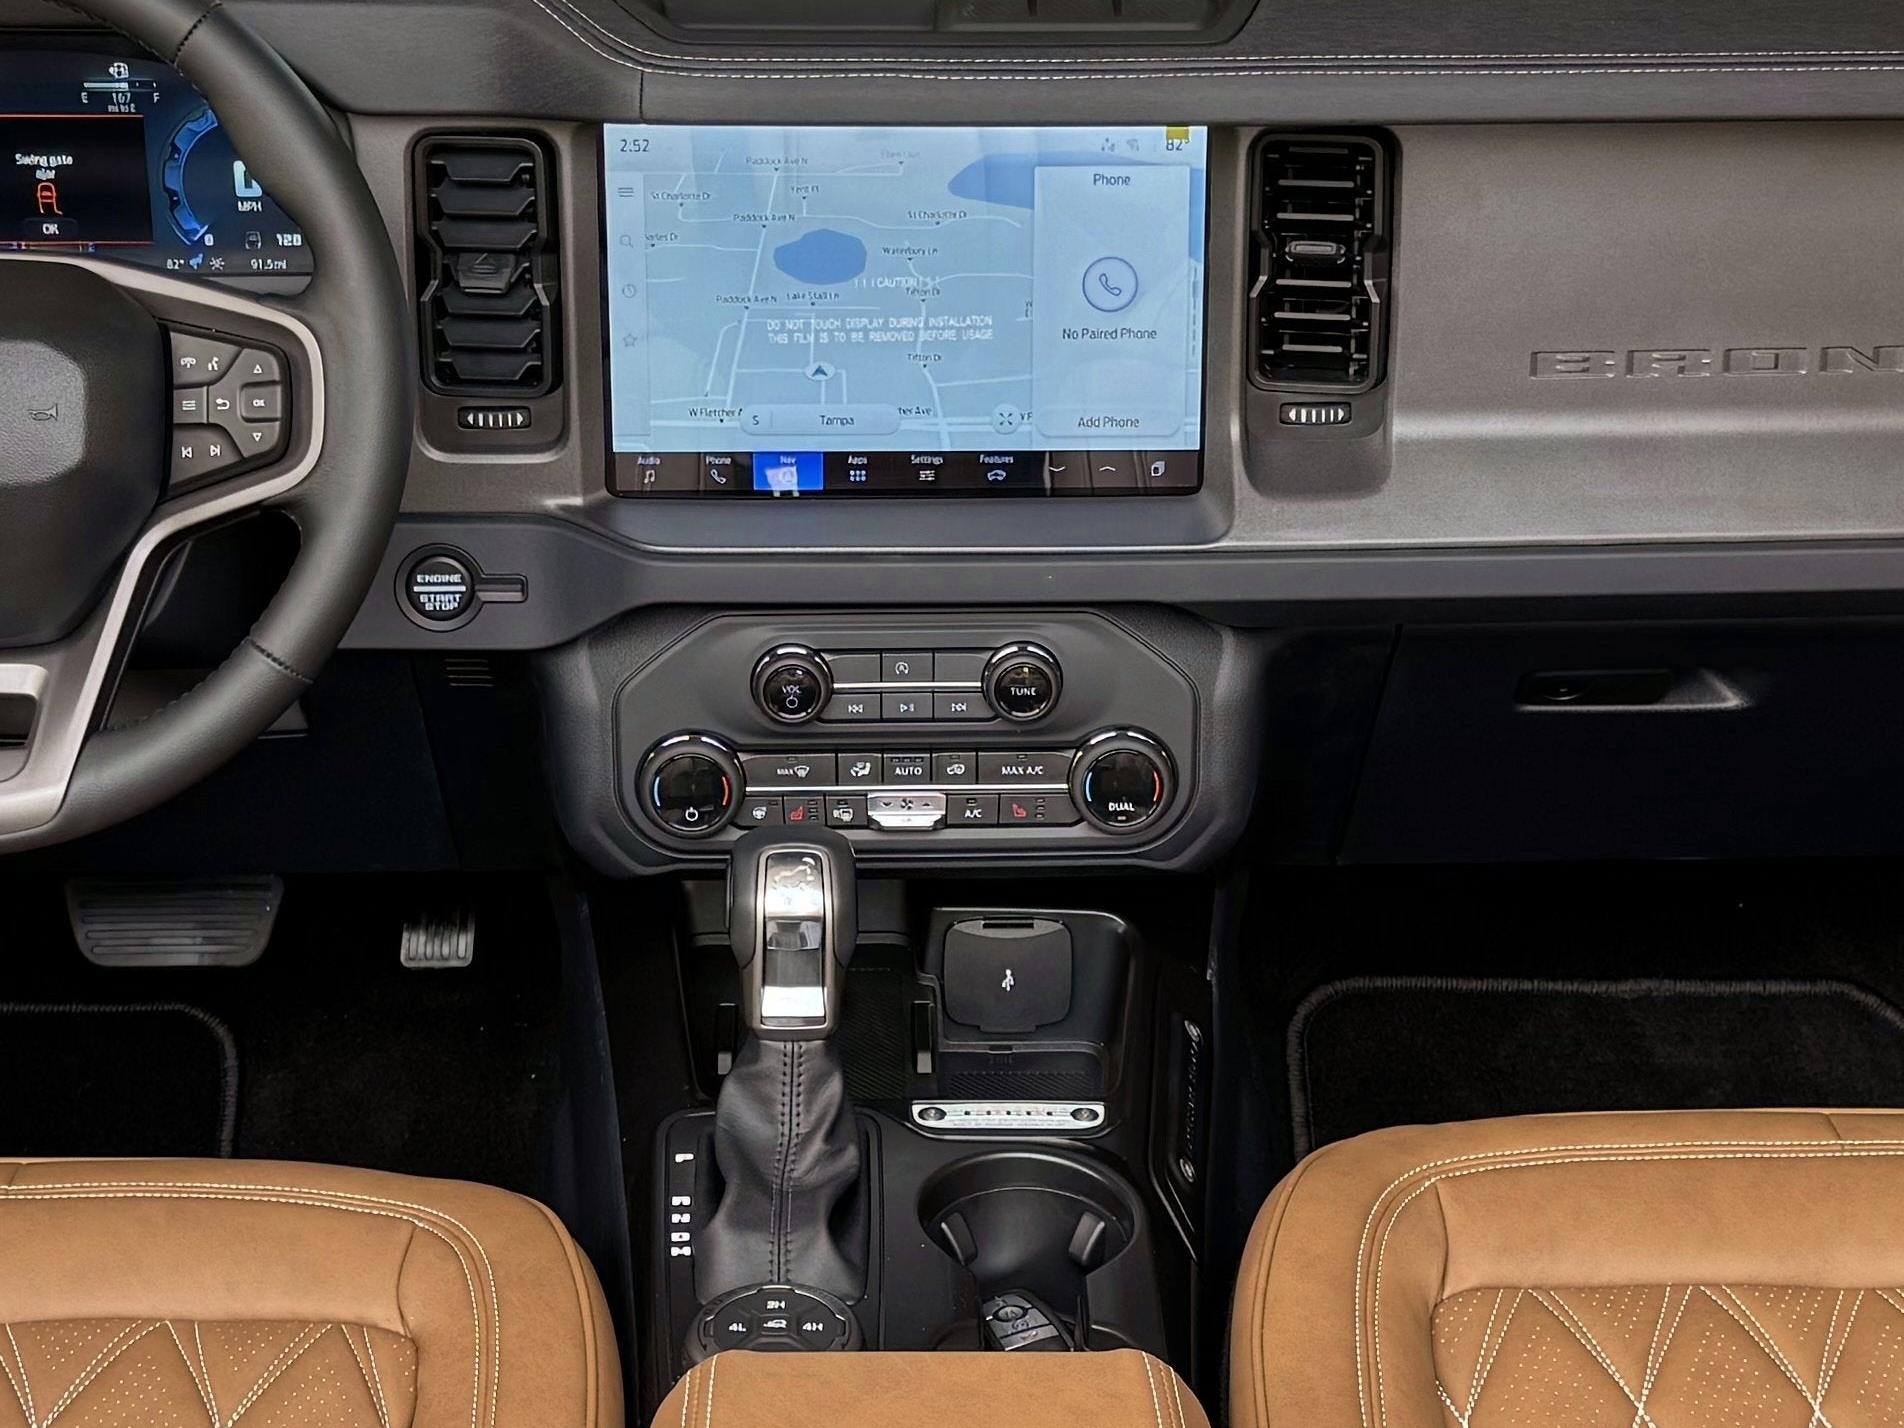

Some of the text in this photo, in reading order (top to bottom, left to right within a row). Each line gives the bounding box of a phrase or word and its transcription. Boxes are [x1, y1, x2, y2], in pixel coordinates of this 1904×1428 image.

[81, 92, 88, 104] E
[153, 92, 160, 104] F
[620, 138, 650, 153] 2:52
[15, 154, 47, 167] Swing
[1093, 173, 1131, 185] Phone
[237, 200, 262, 212] MPH
[42, 223, 59, 235] OK
[767, 319, 781, 330] DO
[785, 318, 804, 330] NOT
[846, 317, 884, 329] DISPLAY
[928, 315, 993, 327] INSTALLATION
[767, 333, 789, 344] THIS
[819, 332, 829, 343] IS
[834, 332, 846, 342] TO
[851, 331, 865, 342] BE
[869, 330, 915, 342] REMOVED
[1062, 328, 1157, 340] No Paired Phone
[699, 407, 736, 417] Fletcher
[752, 414, 760, 426] S
[819, 415, 855, 427] Tampa
[1077, 416, 1140, 428] Add Phone
[637, 455, 661, 465] Audio
[705, 455, 732, 465] Phone
[780, 455, 796, 464] Nav
[847, 455, 867, 466] Apps
[910, 454, 944, 466] Settings
[979, 454, 1014, 464] Features
[416, 573, 462, 583] ENGINE
[419, 594, 462, 603] START
[425, 602, 459, 611] STOP
[781, 684, 802, 695] VOL
[1010, 686, 1037, 696] TUNE
[895, 767, 922, 776] AUTO
[1001, 765, 1044, 775] MAX A/C
[1108, 802, 1135, 812] DUAL
[964, 809, 982, 818] A/C
[766, 1300, 786, 1309] 2H
[728, 1322, 747, 1332] 4L
[802, 1322, 824, 1332] 4H
